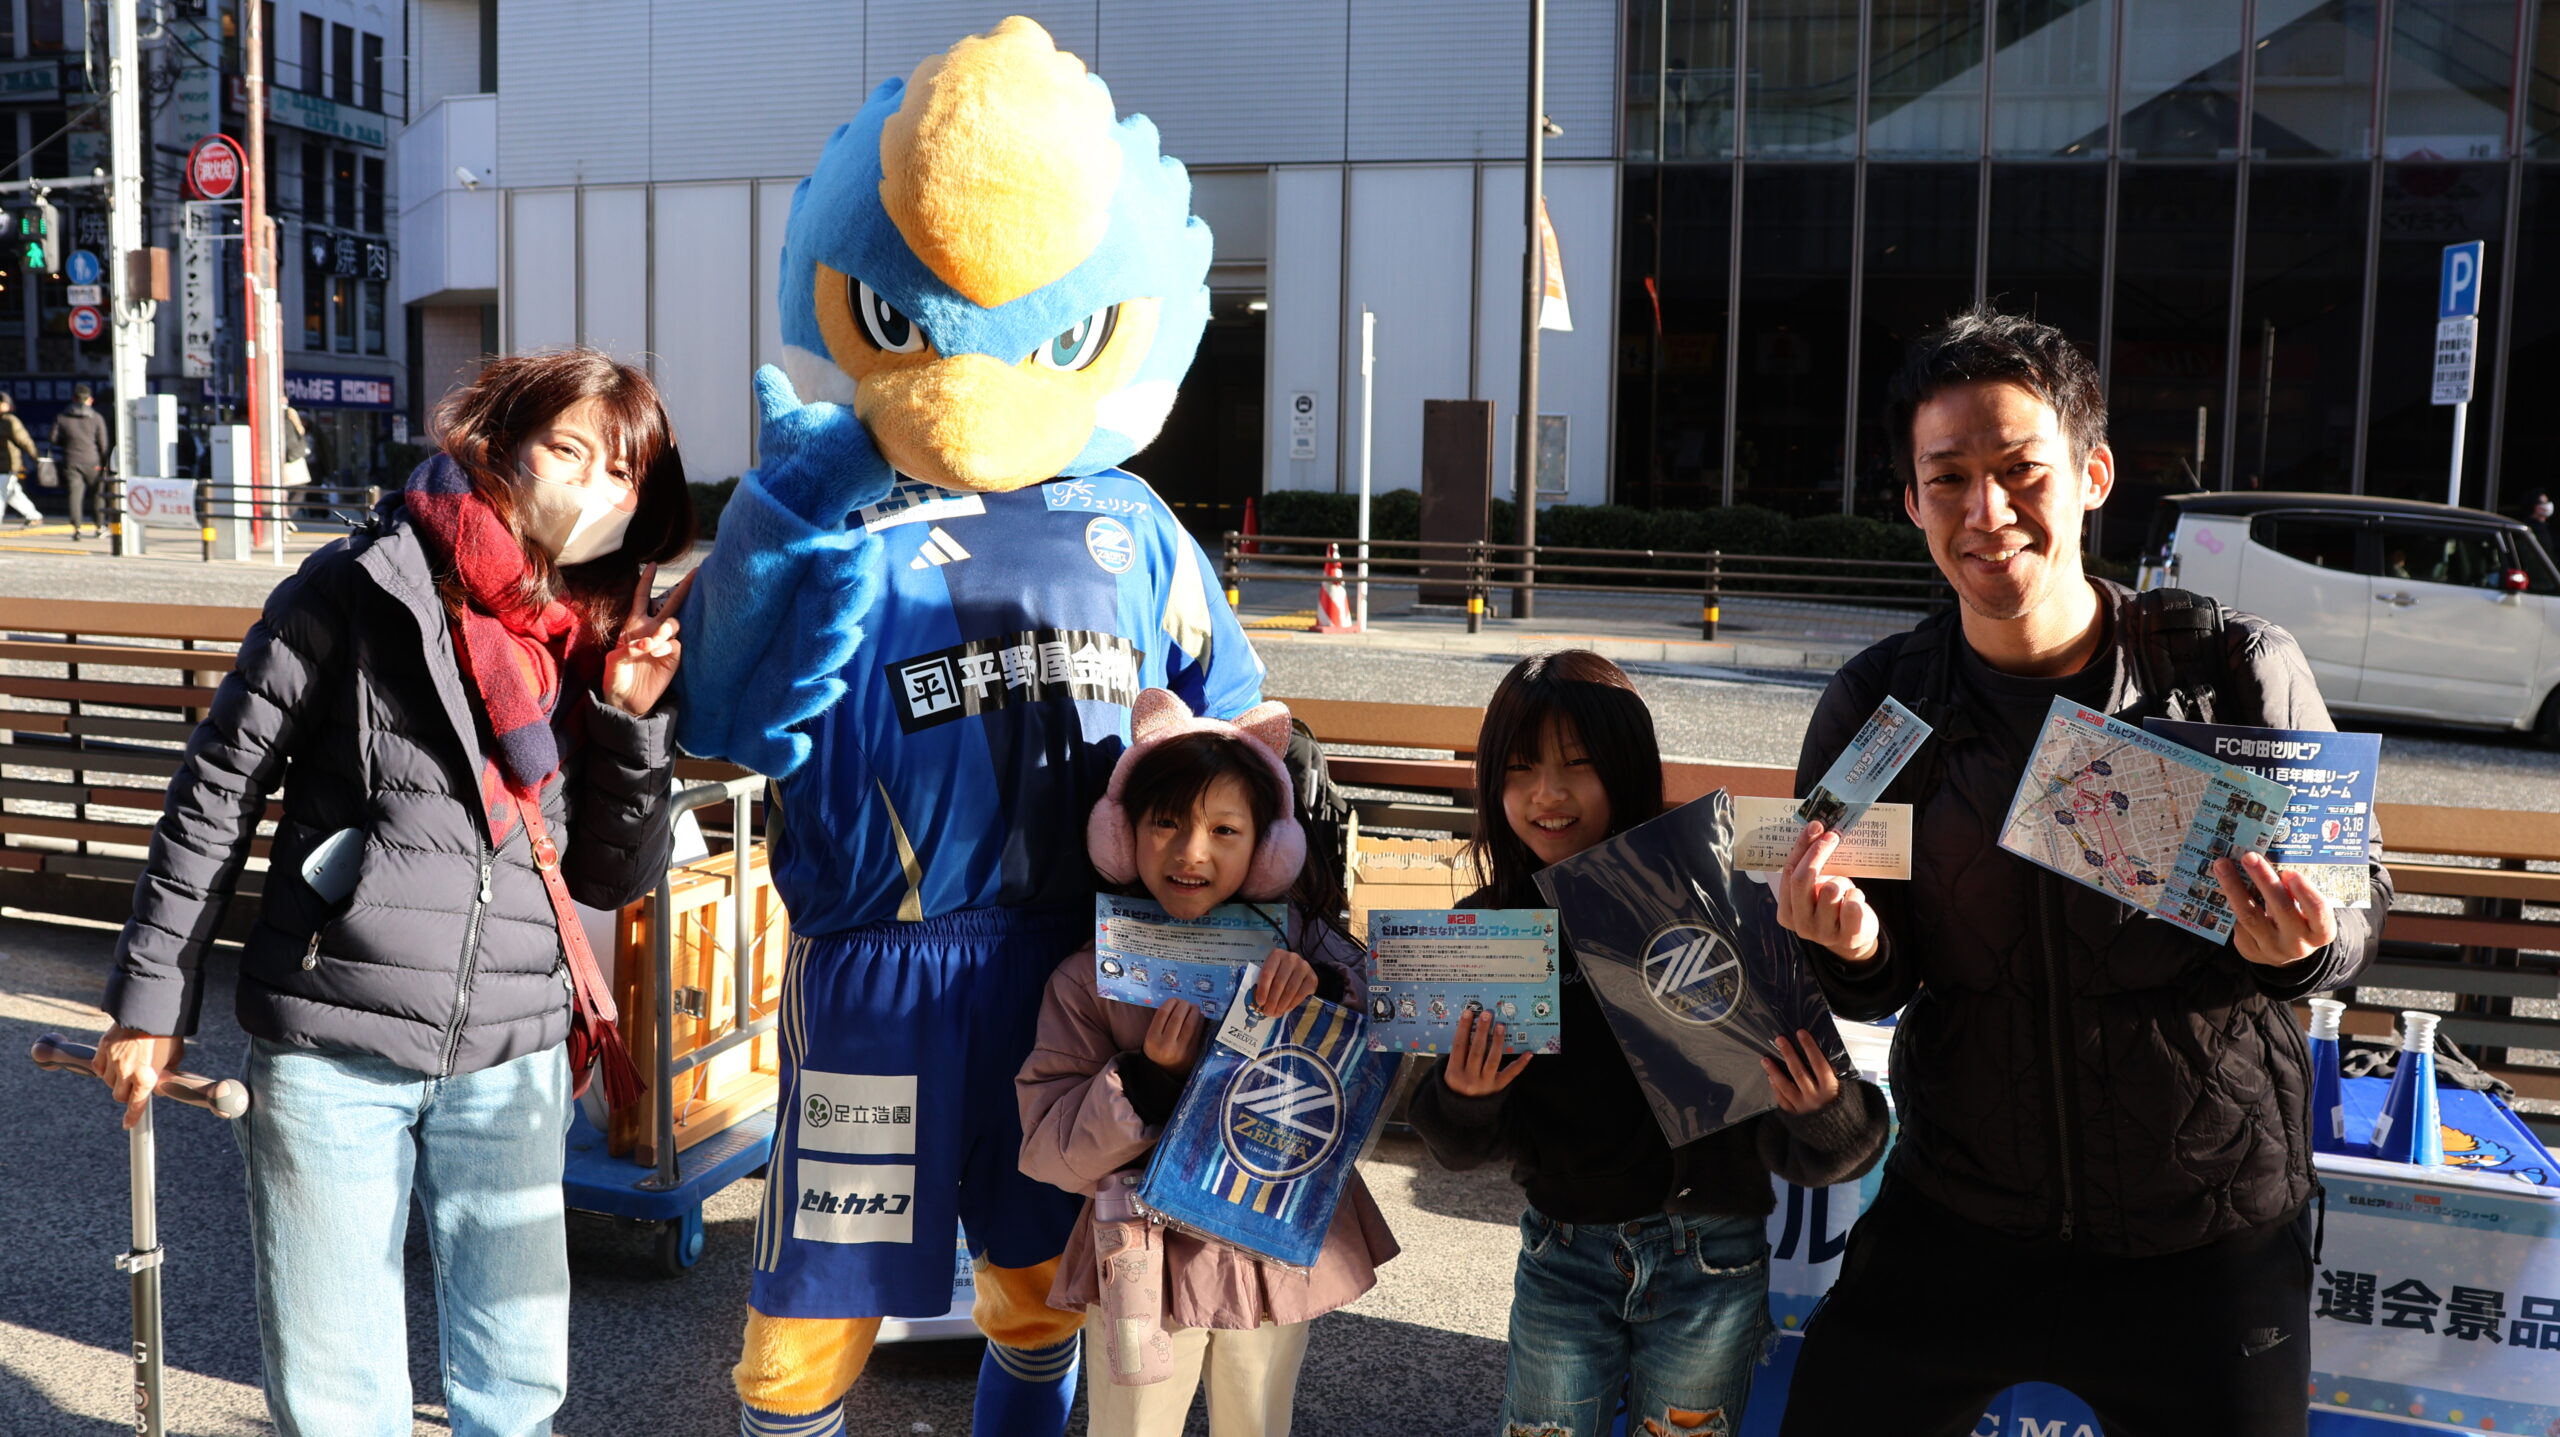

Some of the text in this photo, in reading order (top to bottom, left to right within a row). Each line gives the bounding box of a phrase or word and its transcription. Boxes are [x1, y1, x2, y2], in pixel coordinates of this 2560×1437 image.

[199, 159, 232, 181] 消火栓
[335, 233, 388, 281] 焼肉
[2448, 252, 2474, 311] P
[1078, 496, 1148, 514] フェリシア
[1845, 713, 1907, 785] 特別サービス券
[2075, 709, 2105, 729] 第2回
[2106, 720, 2222, 774] ゼルビアまちなかスタンプウォーク
[2215, 737, 2321, 760] FC町田ゼルビア
[1855, 821, 1887, 830] 0円割引
[2292, 816, 2307, 827] 3.7
[2342, 816, 2364, 832] 3.18
[1447, 914, 1476, 925] 第2回
[1382, 926, 1542, 937] ゼルビアまちなかスタンプウォーク
[1228, 1026, 1258, 1048] ZELVIA
[834, 1105, 911, 1124] 足立造園
[1233, 1112, 1308, 1160] ZELVIA
